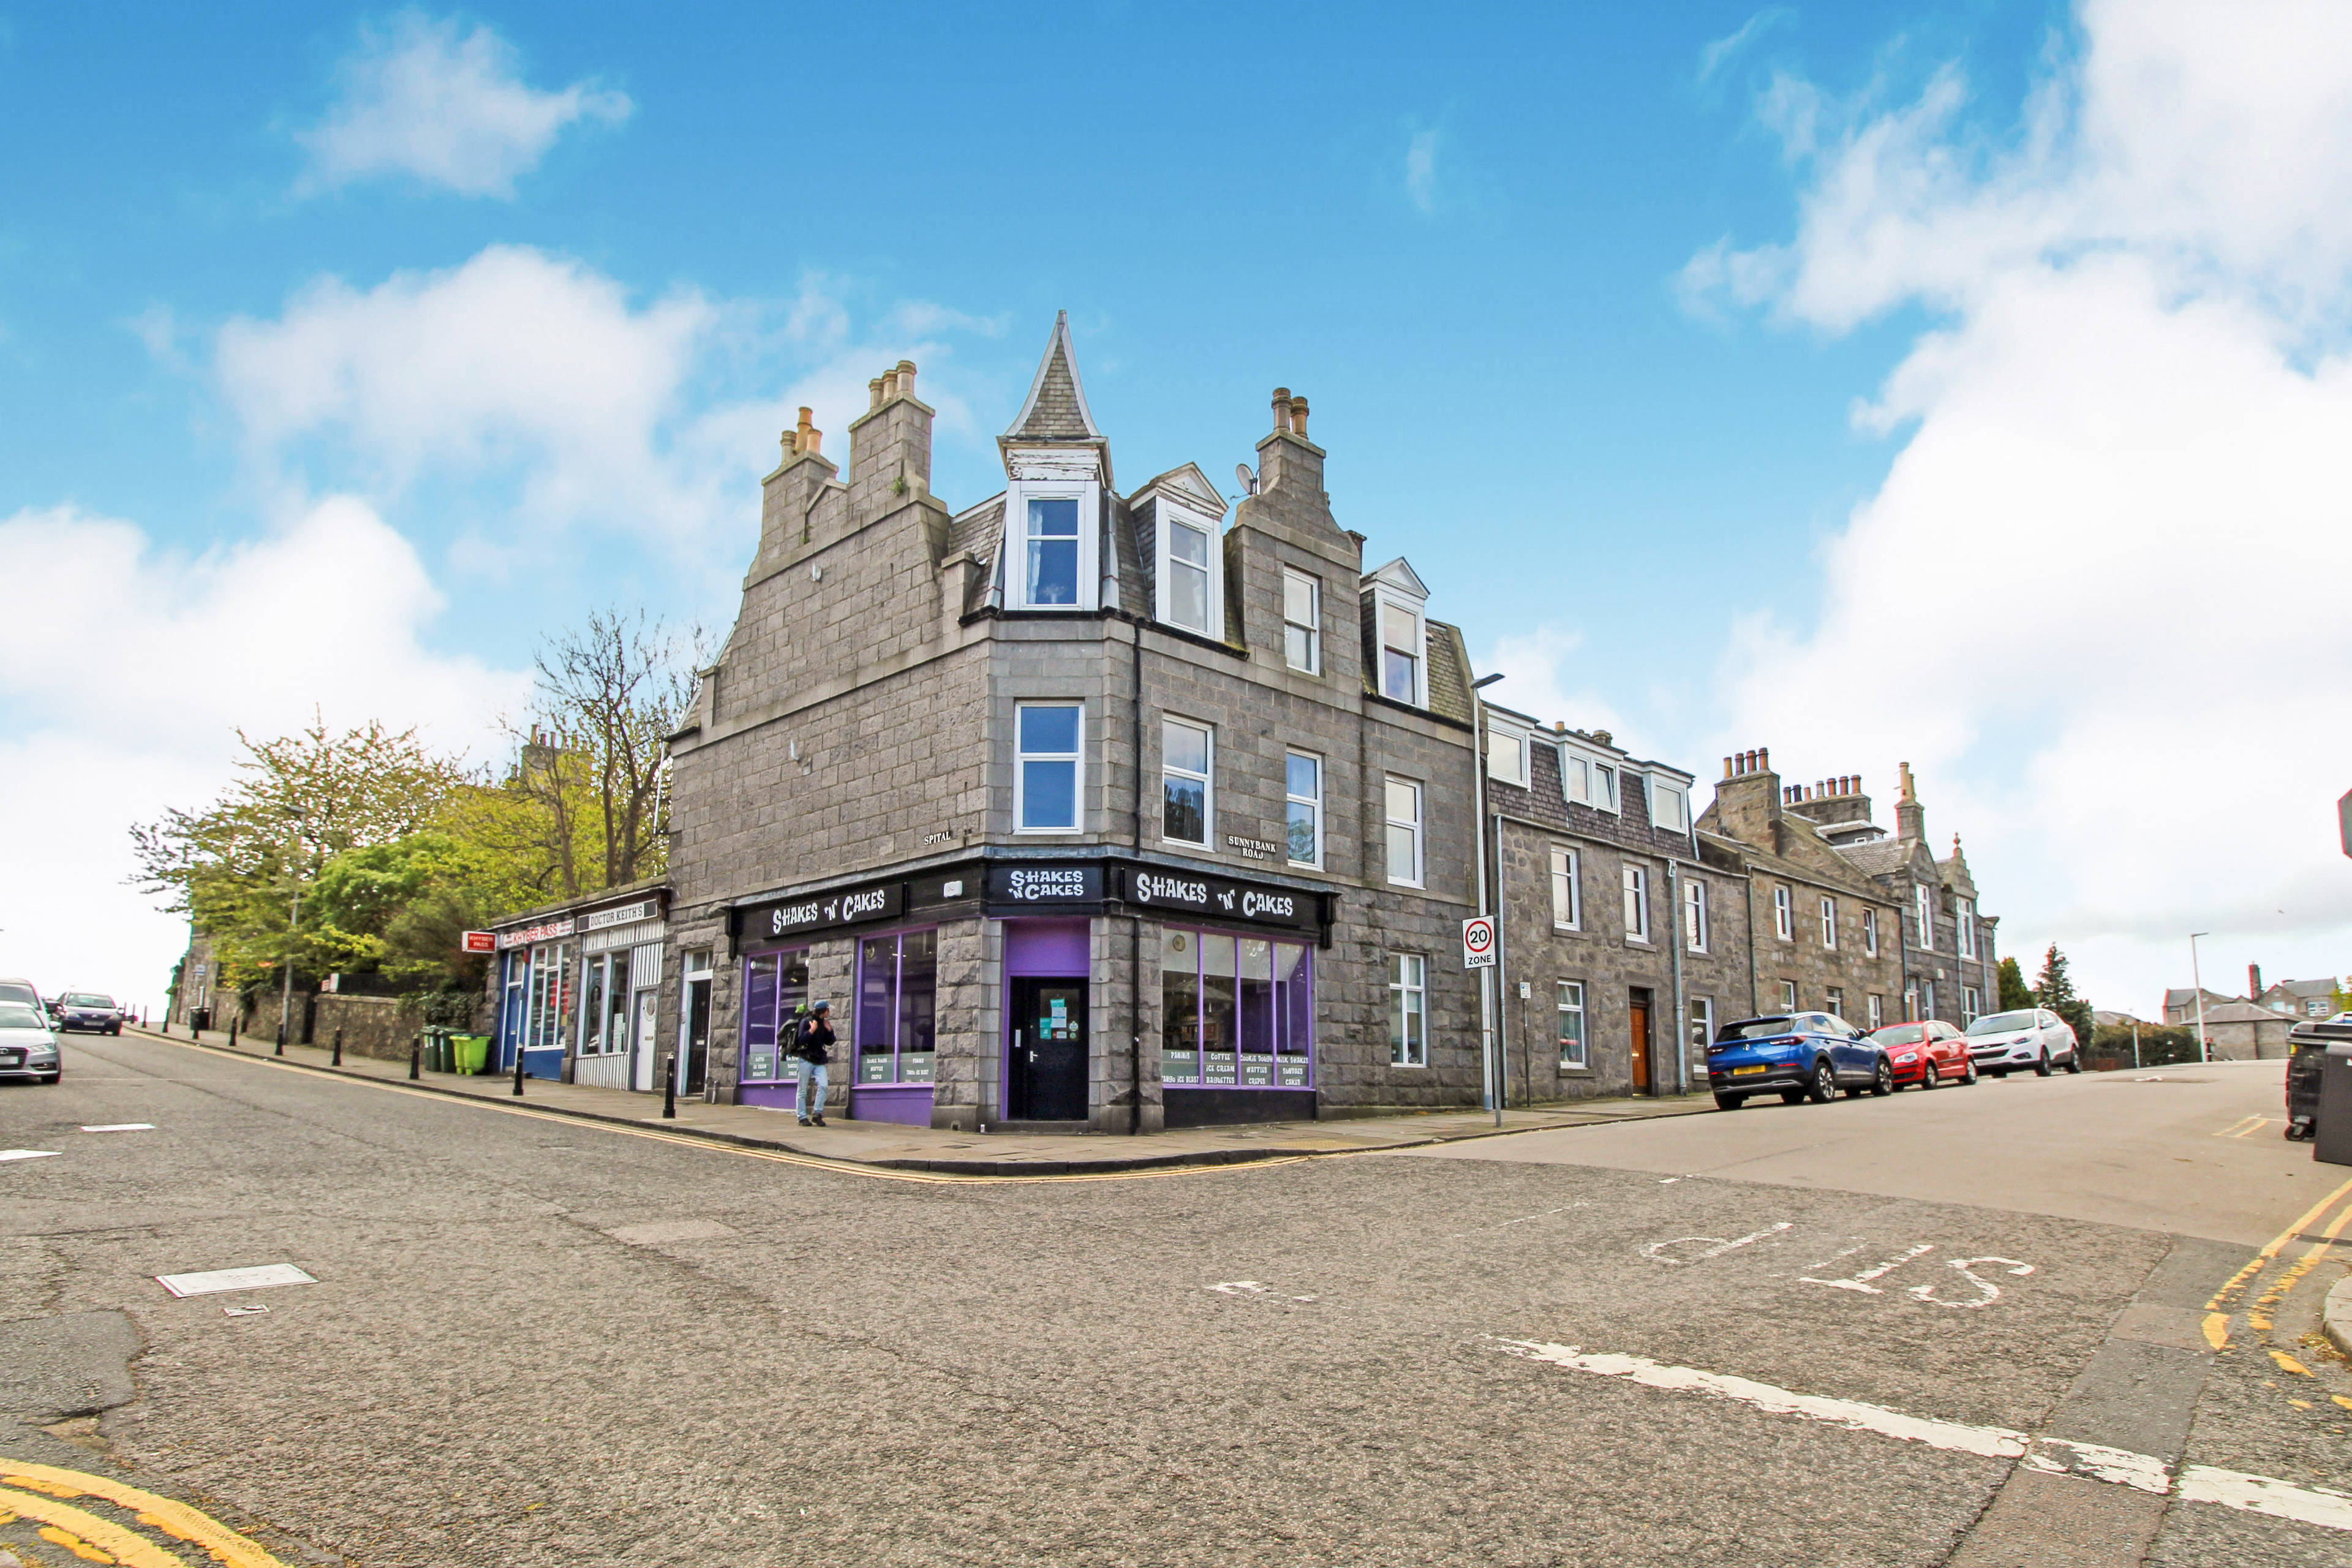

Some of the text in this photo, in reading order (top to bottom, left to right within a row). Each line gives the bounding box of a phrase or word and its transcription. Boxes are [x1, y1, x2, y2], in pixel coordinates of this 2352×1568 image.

[924, 831, 951, 845] SPITAL
[1228, 835, 1276, 853] SUNNYBANK
[1242, 847, 1264, 859] ROAD
[1011, 870, 1084, 887] SHAKES
[1025, 884, 1084, 900] CAKES
[1137, 873, 1207, 903] SHAKES
[1243, 891, 1294, 917] CAKES
[590, 906, 643, 927] DOCTOR KEITH'S
[773, 902, 818, 934] SHAKES
[843, 889, 885, 921] CAKES
[513, 922, 557, 943] KHYBER PASS
[1470, 929, 1488, 943] 20
[1468, 955, 1491, 965] ZONE
